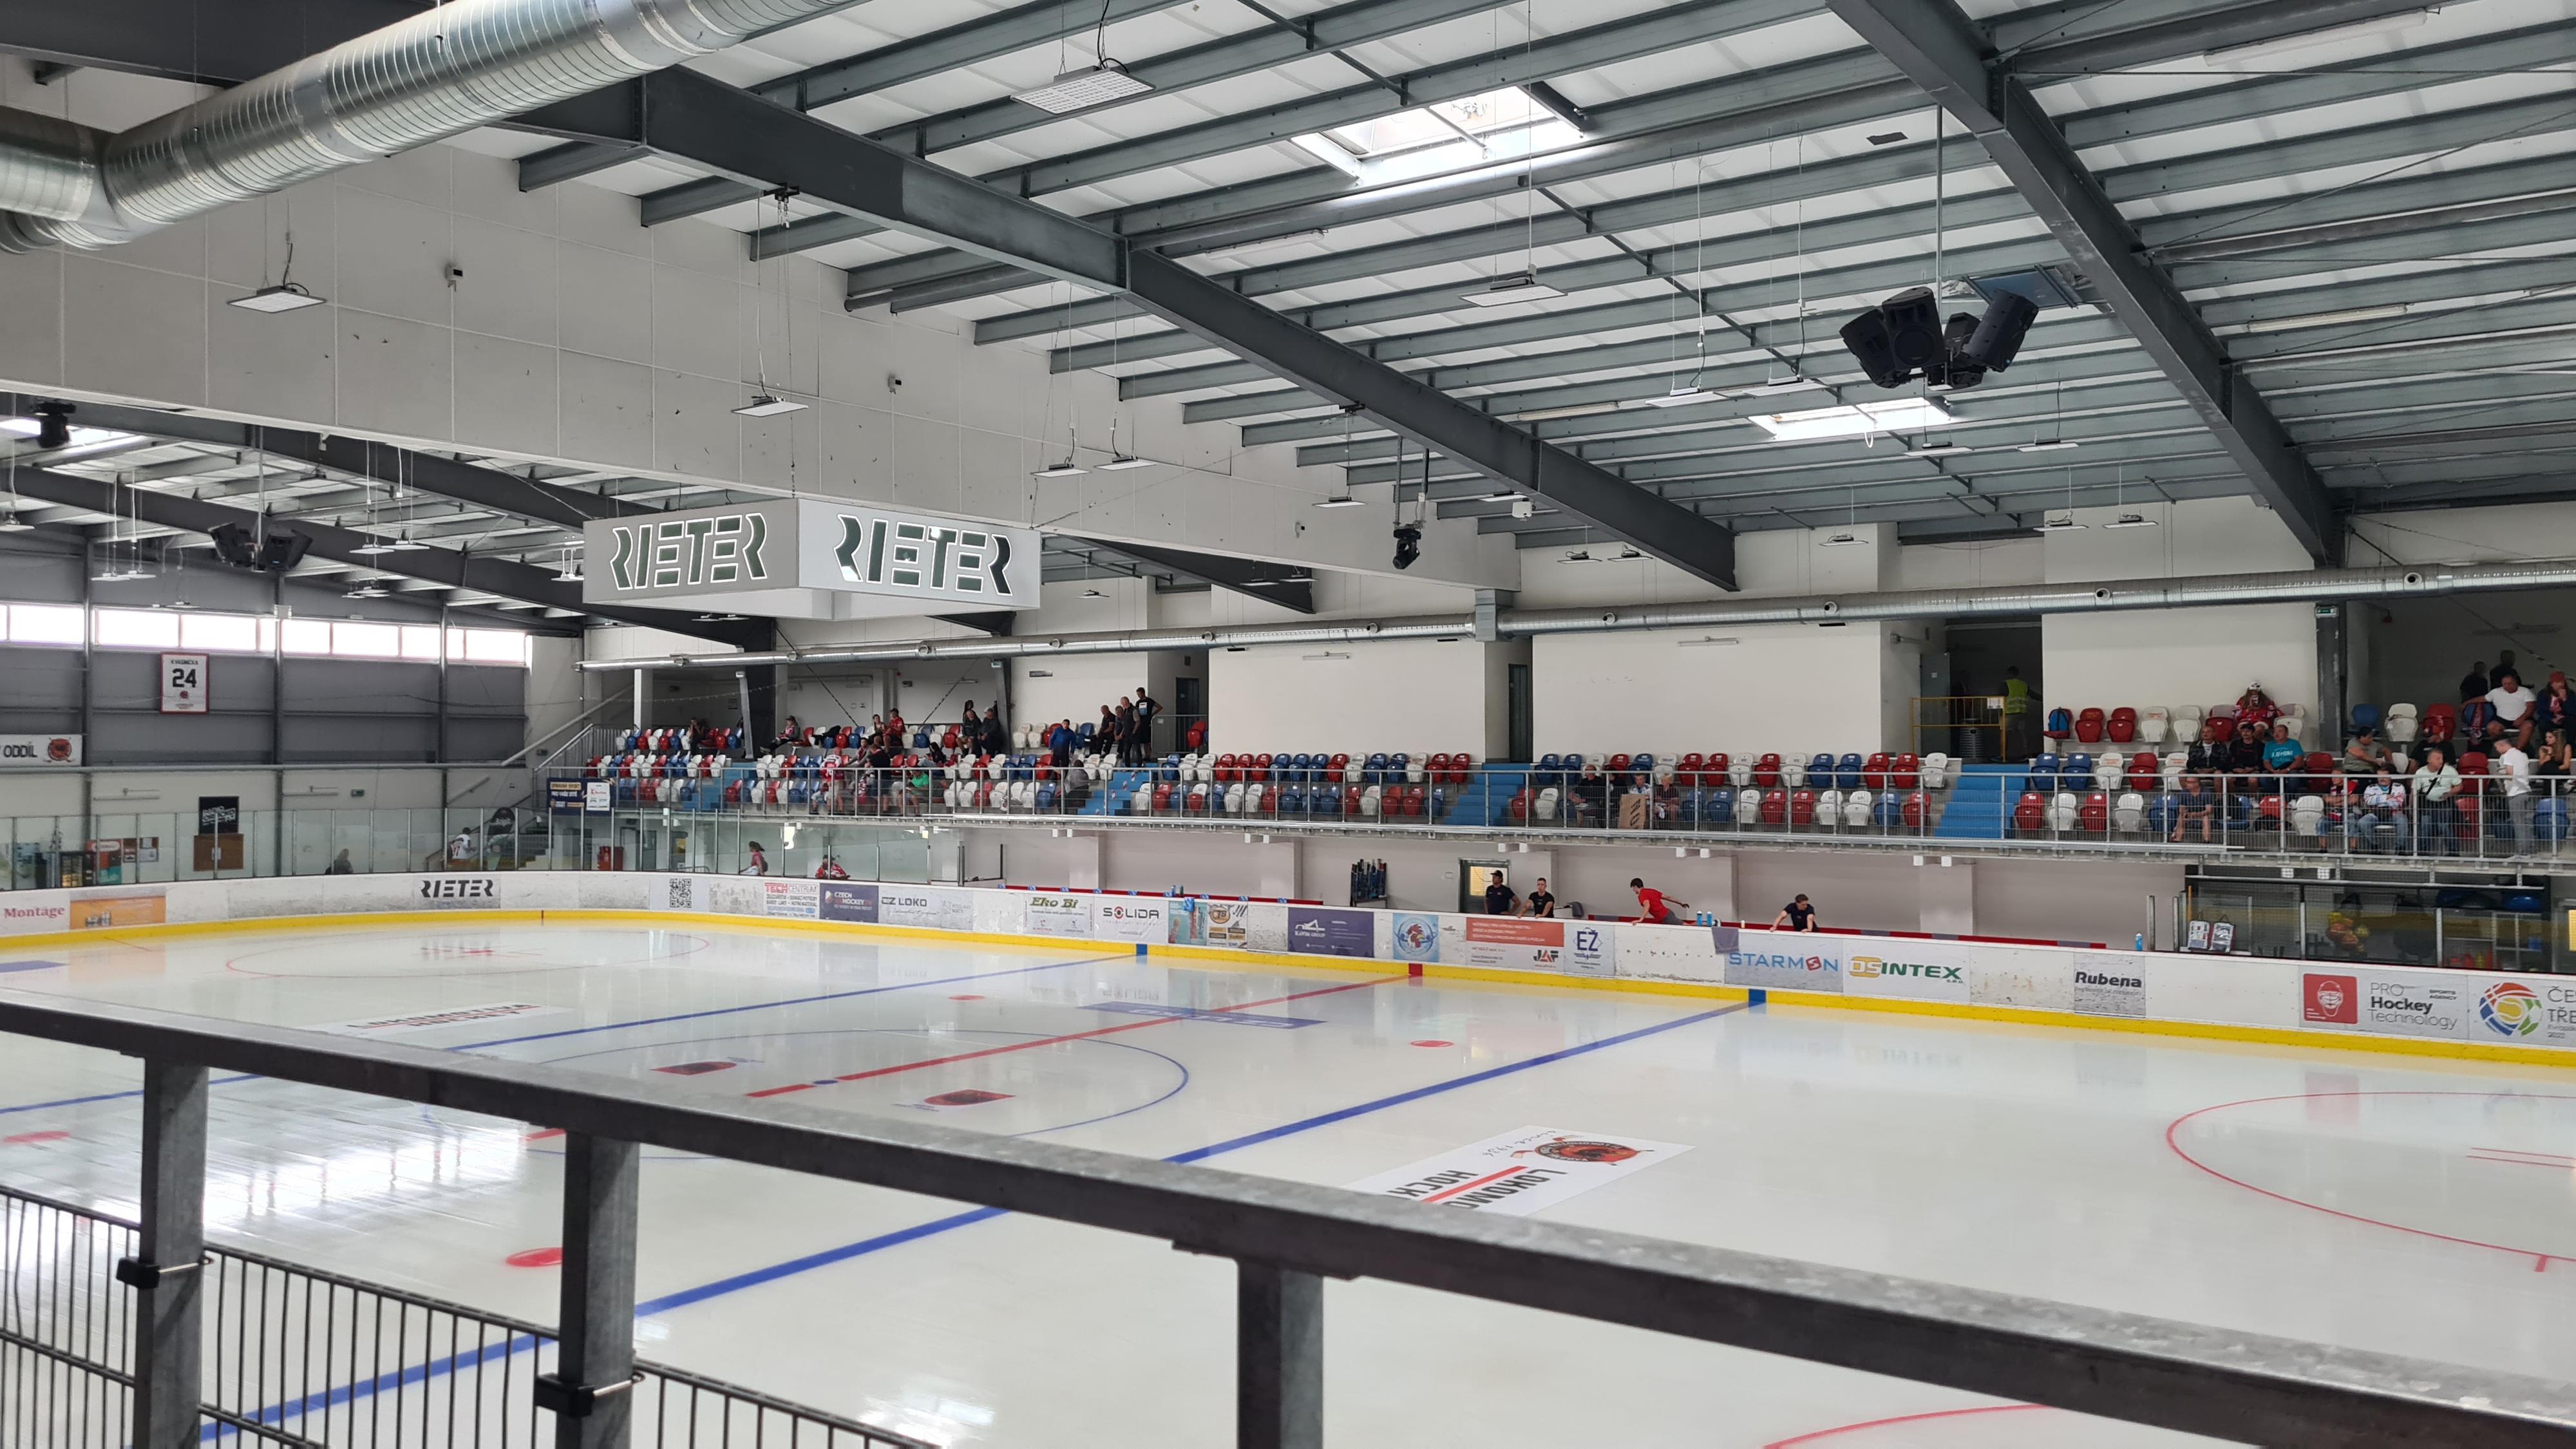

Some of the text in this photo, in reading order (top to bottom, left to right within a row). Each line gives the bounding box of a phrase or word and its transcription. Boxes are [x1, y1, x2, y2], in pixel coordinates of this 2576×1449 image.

[610, 513, 767, 590] RIETER
[833, 514, 1012, 596] RIETER
[173, 668, 197, 688] 24
[3, 742, 37, 757] ODDÍL
[421, 880, 493, 898] RIETER
[898, 898, 927, 907] LOKO
[1030, 897, 1058, 907] Eko
[1061, 899, 1078, 908] Bi
[4, 905, 65, 918] Montage
[1103, 906, 1159, 919] SOLIDA
[1577, 930, 1598, 951] EŽ
[1533, 949, 1558, 962] JAF
[2075, 971, 2142, 988] Rubena
[2371, 982, 2404, 996] PRO
[2548, 986, 2576, 1003] ČE
[2371, 996, 2433, 1014] Hockey
[2367, 1009, 2458, 1030] Technology
